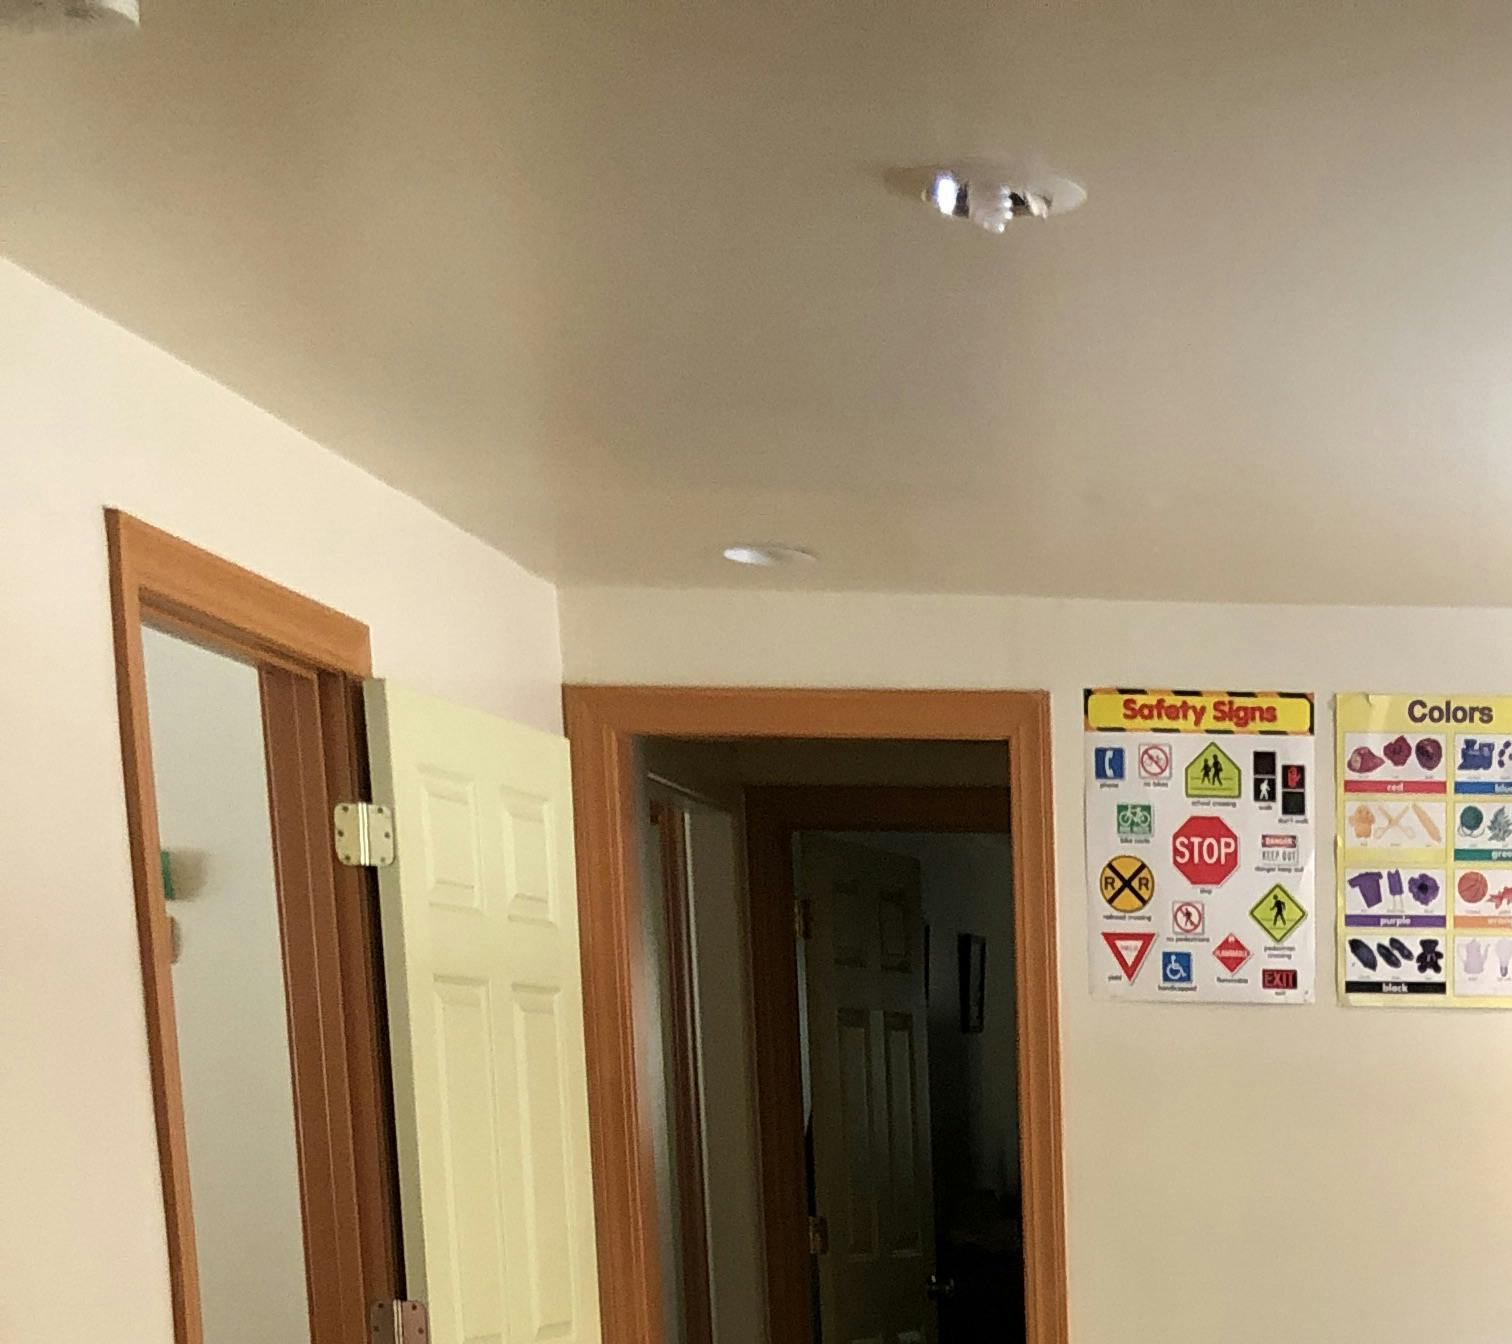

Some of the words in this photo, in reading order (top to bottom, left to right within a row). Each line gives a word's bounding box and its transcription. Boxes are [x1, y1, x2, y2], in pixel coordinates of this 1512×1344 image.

[1122, 698, 1206, 726] Safety
[1212, 699, 1278, 727] Signs
[1407, 699, 1494, 724] Colors
[1387, 783, 1404, 792] red
[1175, 836, 1236, 865] STOP
[1262, 850, 1280, 863] KEEP
[1283, 850, 1297, 863] OUT
[1104, 877, 1116, 891] R
[1138, 877, 1150, 891] R
[1380, 916, 1411, 927] purple
[1264, 972, 1296, 987] EXIT
[1382, 982, 1409, 993] black
